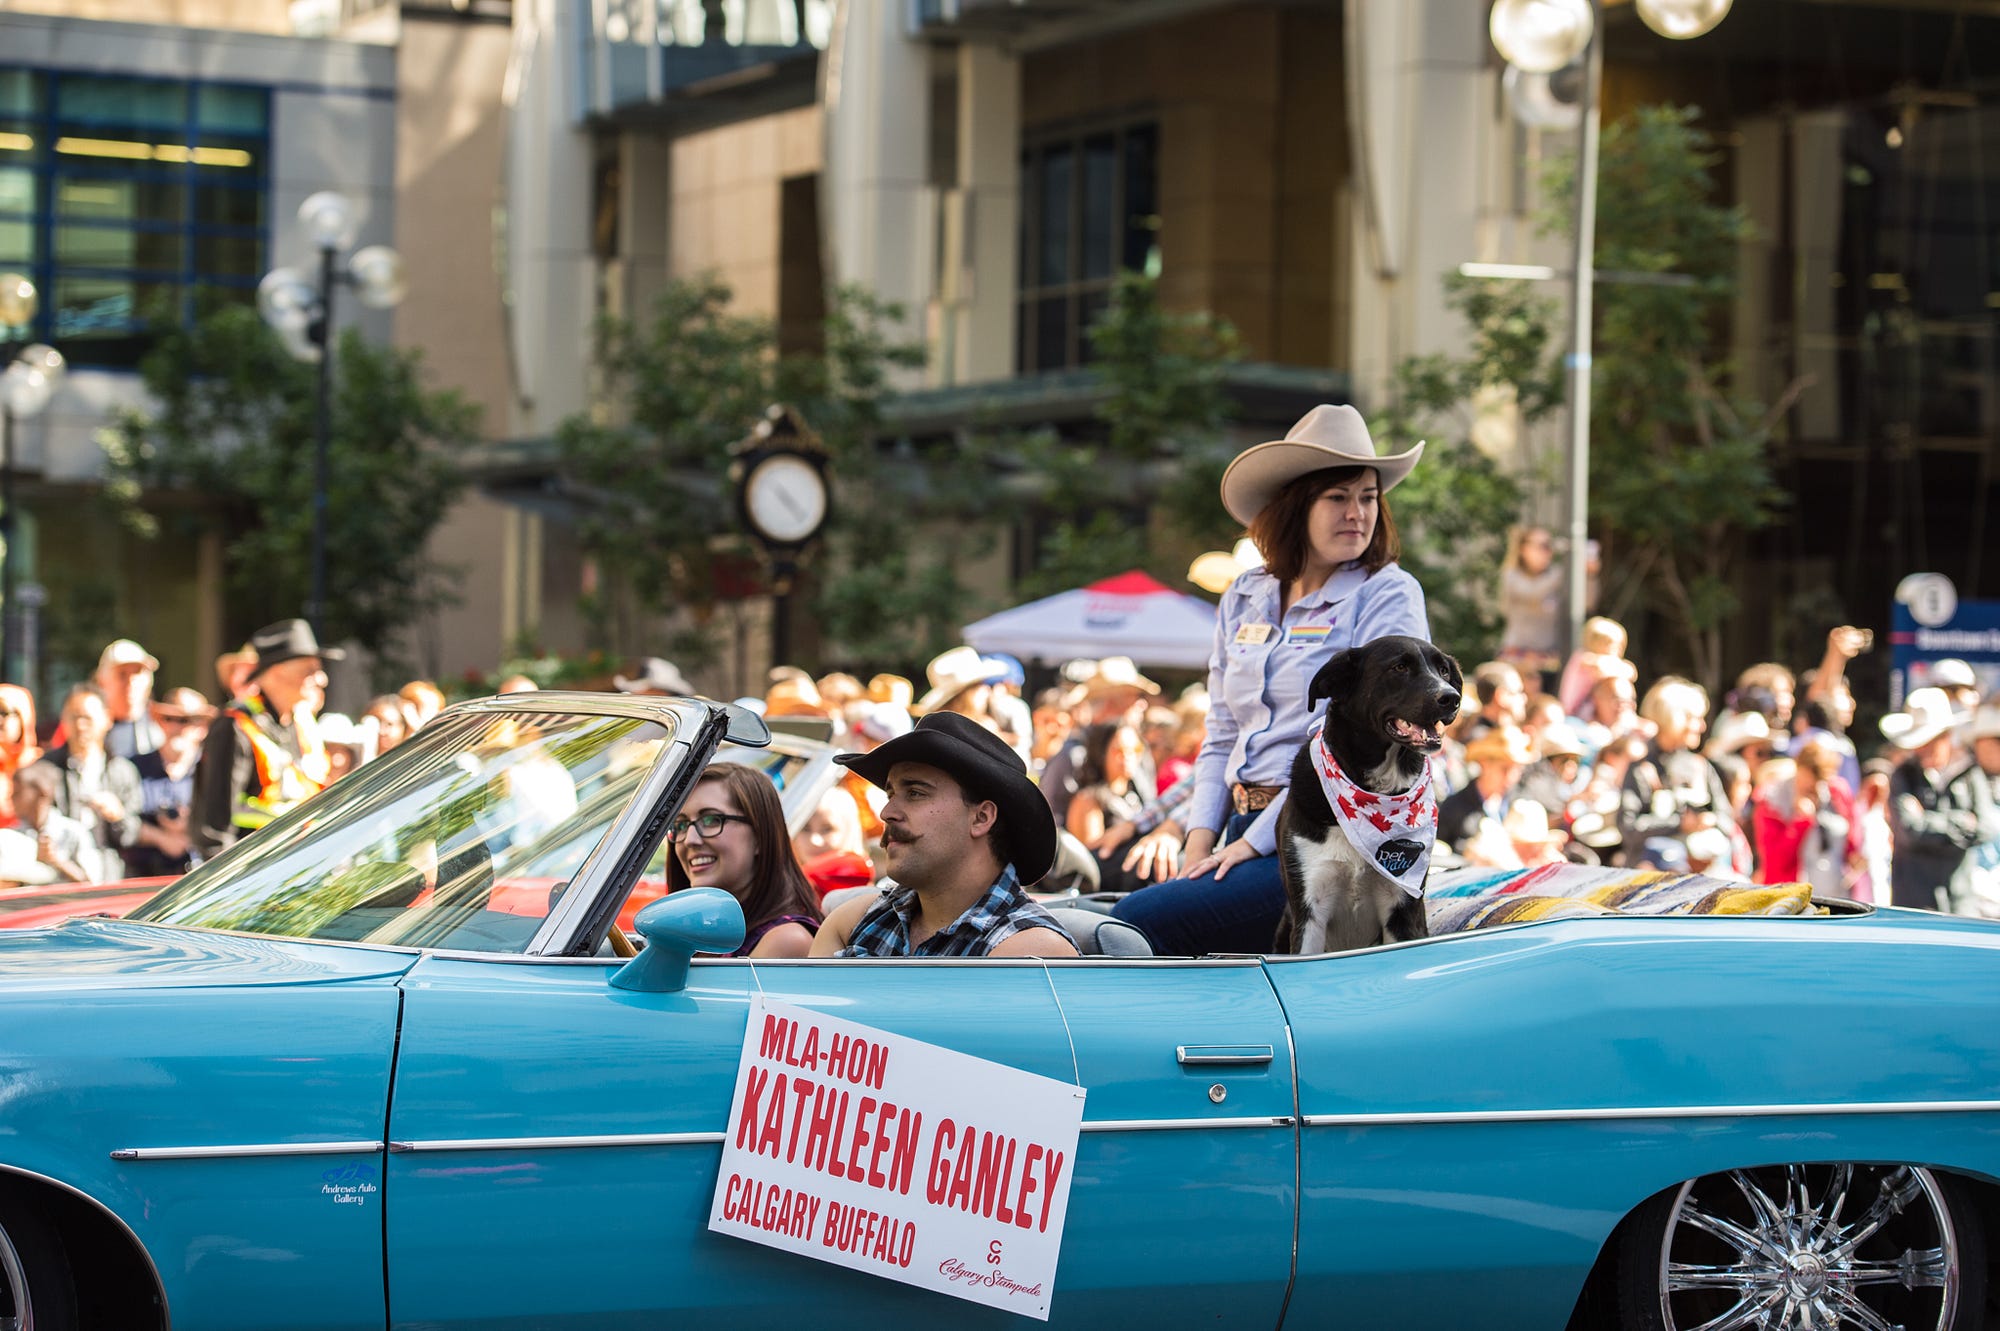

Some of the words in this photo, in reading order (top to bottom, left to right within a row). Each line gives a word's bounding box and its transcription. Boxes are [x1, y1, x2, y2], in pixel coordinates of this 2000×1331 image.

[1378, 850, 1405, 862] pet
[759, 1013, 889, 1090] MLA-HON
[736, 1065, 922, 1195] KATHLEEN
[926, 1118, 1064, 1234] GANLEY
[321, 1184, 357, 1194] Andrews
[357, 1183, 377, 1193] Auto
[333, 1194, 364, 1206] Gallery
[723, 1173, 821, 1241] CALGARY
[822, 1201, 916, 1268] BUFFALO
[938, 1258, 984, 1286] Calgary
[983, 1269, 1042, 1297] Stampede
